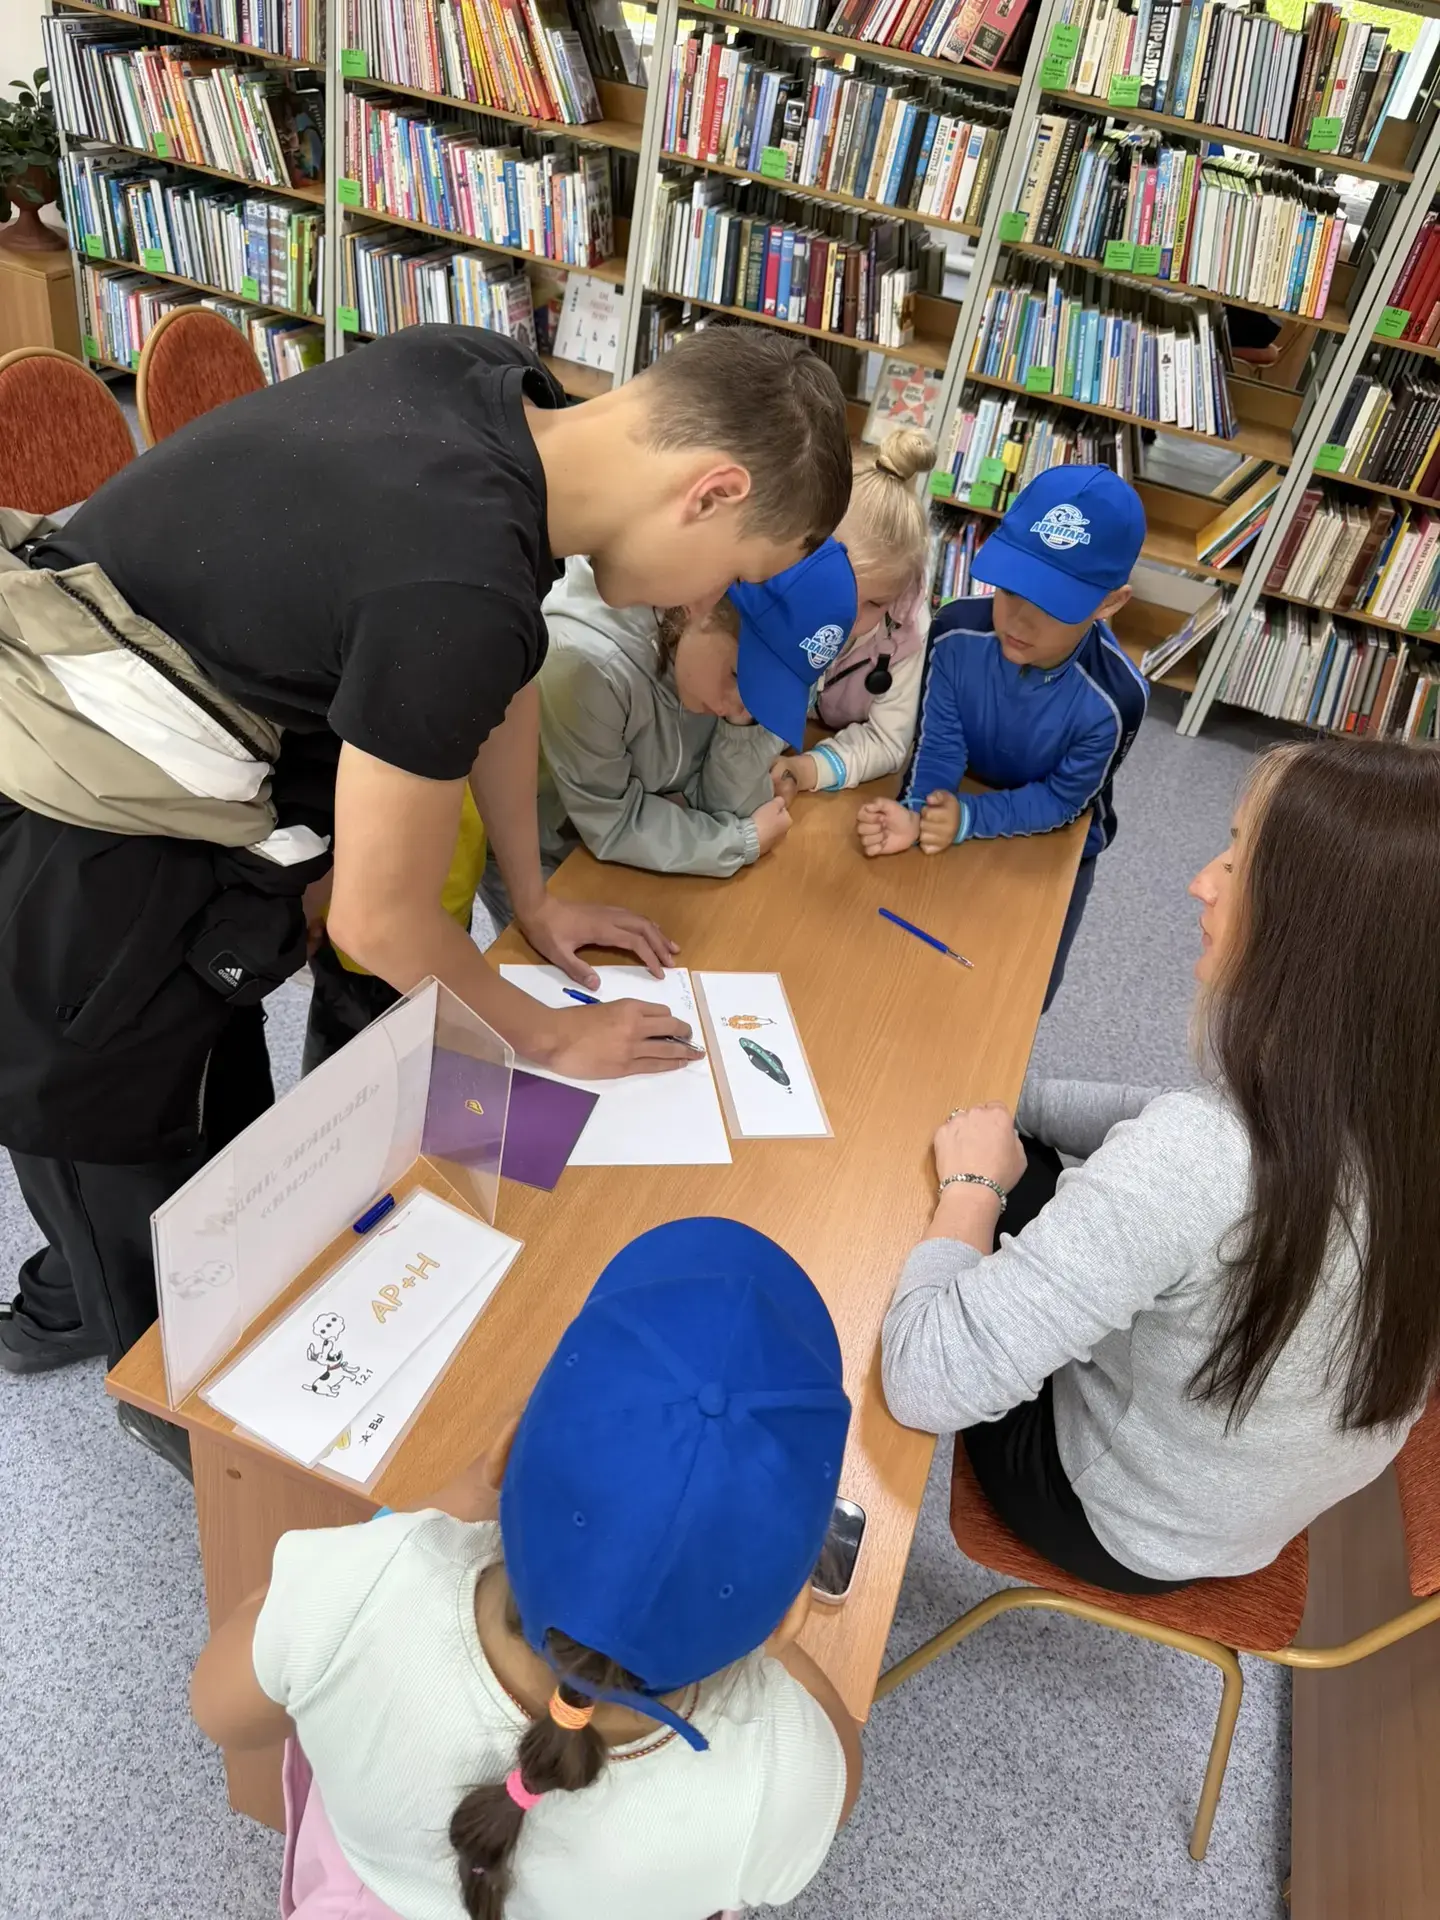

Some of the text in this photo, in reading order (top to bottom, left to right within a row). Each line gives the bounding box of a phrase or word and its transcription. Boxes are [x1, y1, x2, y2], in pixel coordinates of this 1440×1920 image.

[1141, 14, 1167, 87] КОРАБЛЯХ
[709, 82, 725, 149] СРЕДНИЕ ВЕКА
[968, 158, 989, 217] ИСТОРИЯ РОССИИ
[1030, 521, 1091, 545] АВАНГАРД
[1406, 559, 1424, 592] ВЕЛИКИХ
[218, 968, 238, 987] adidas
[368, 1413, 385, 1430] ВЫ
